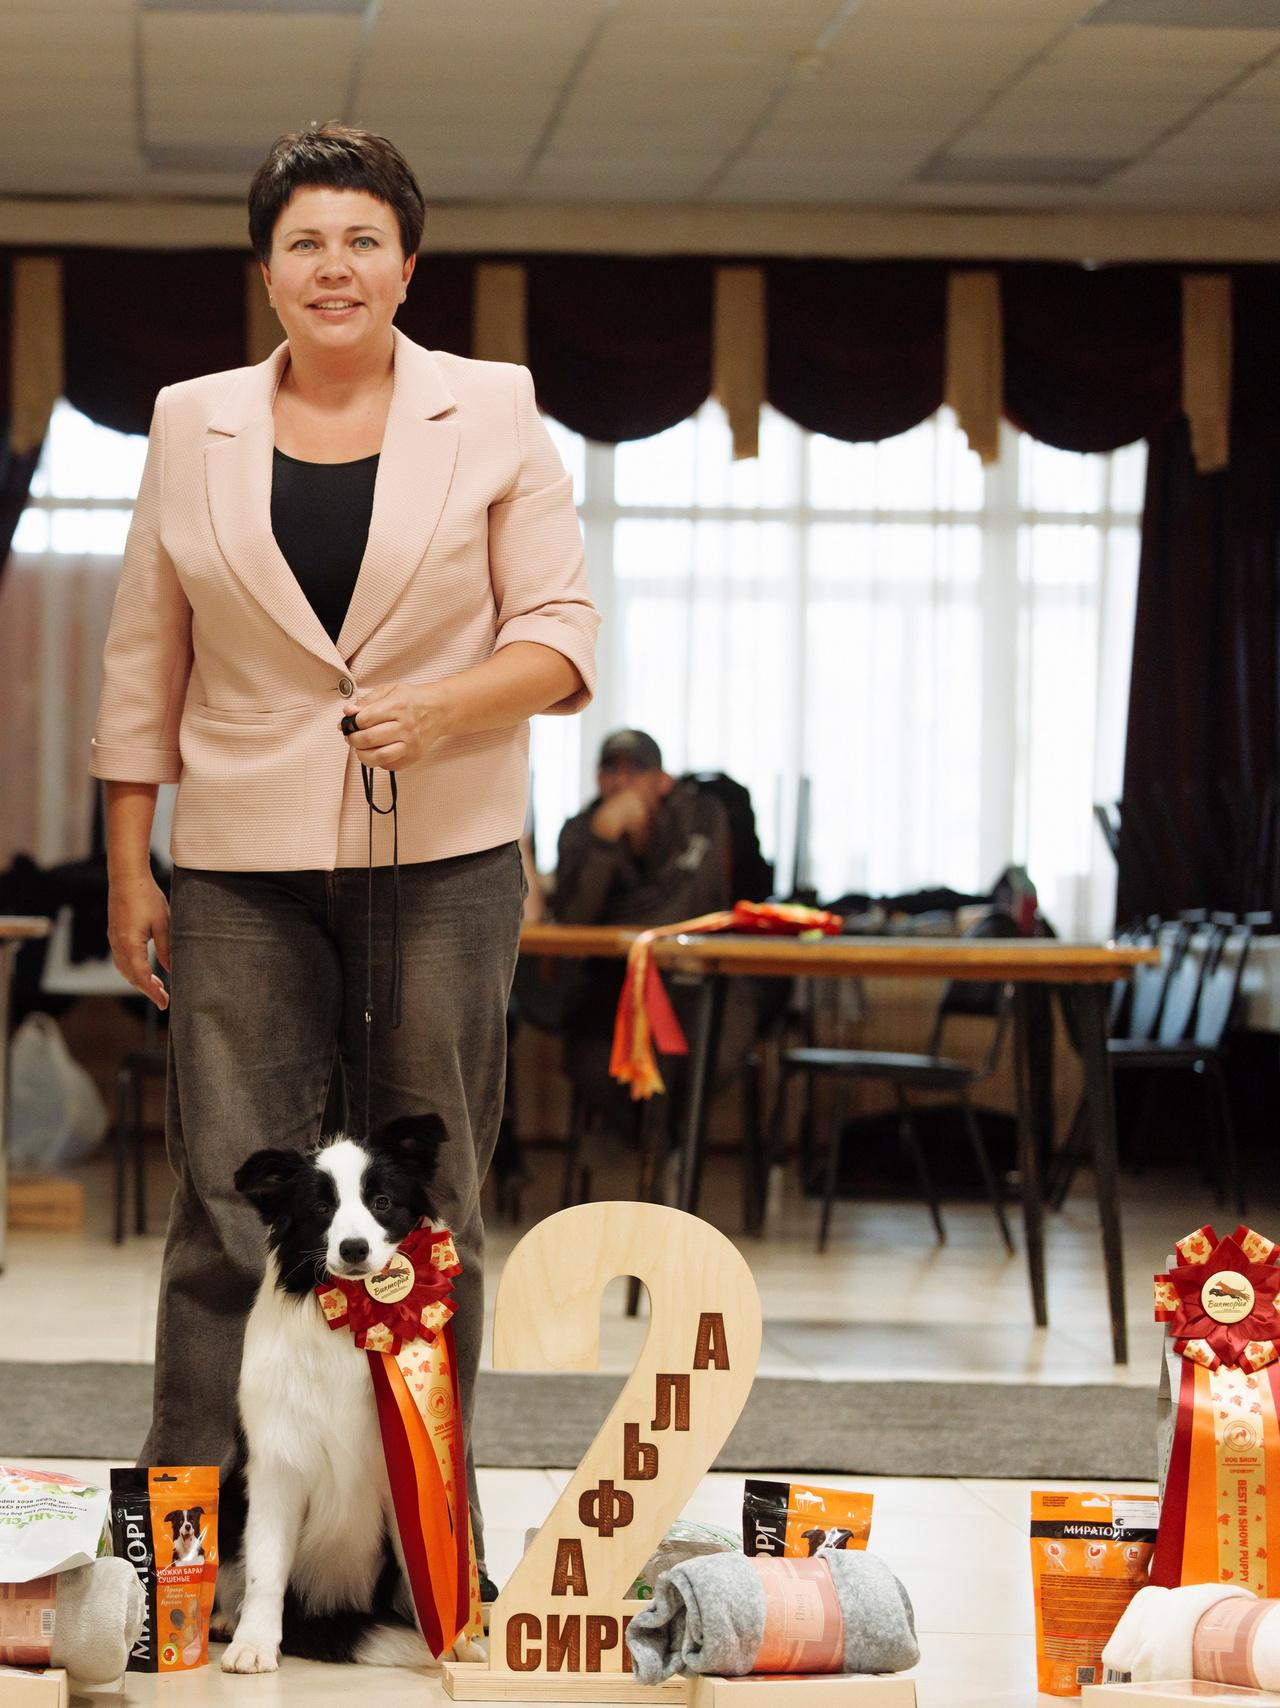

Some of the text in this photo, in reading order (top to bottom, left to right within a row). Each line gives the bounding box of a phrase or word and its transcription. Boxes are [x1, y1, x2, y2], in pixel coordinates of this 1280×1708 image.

[1207, 1299, 1247, 1309] Виктория
[551, 1312, 730, 1597] АЛЬФА
[1237, 1479, 1249, 1582] BEST IN SHOW PUPPY
[156, 1567, 183, 1577] НОЖКИ
[157, 1575, 191, 1584] СУШЕНЫЕ
[795, 1594, 805, 1621] Плед
